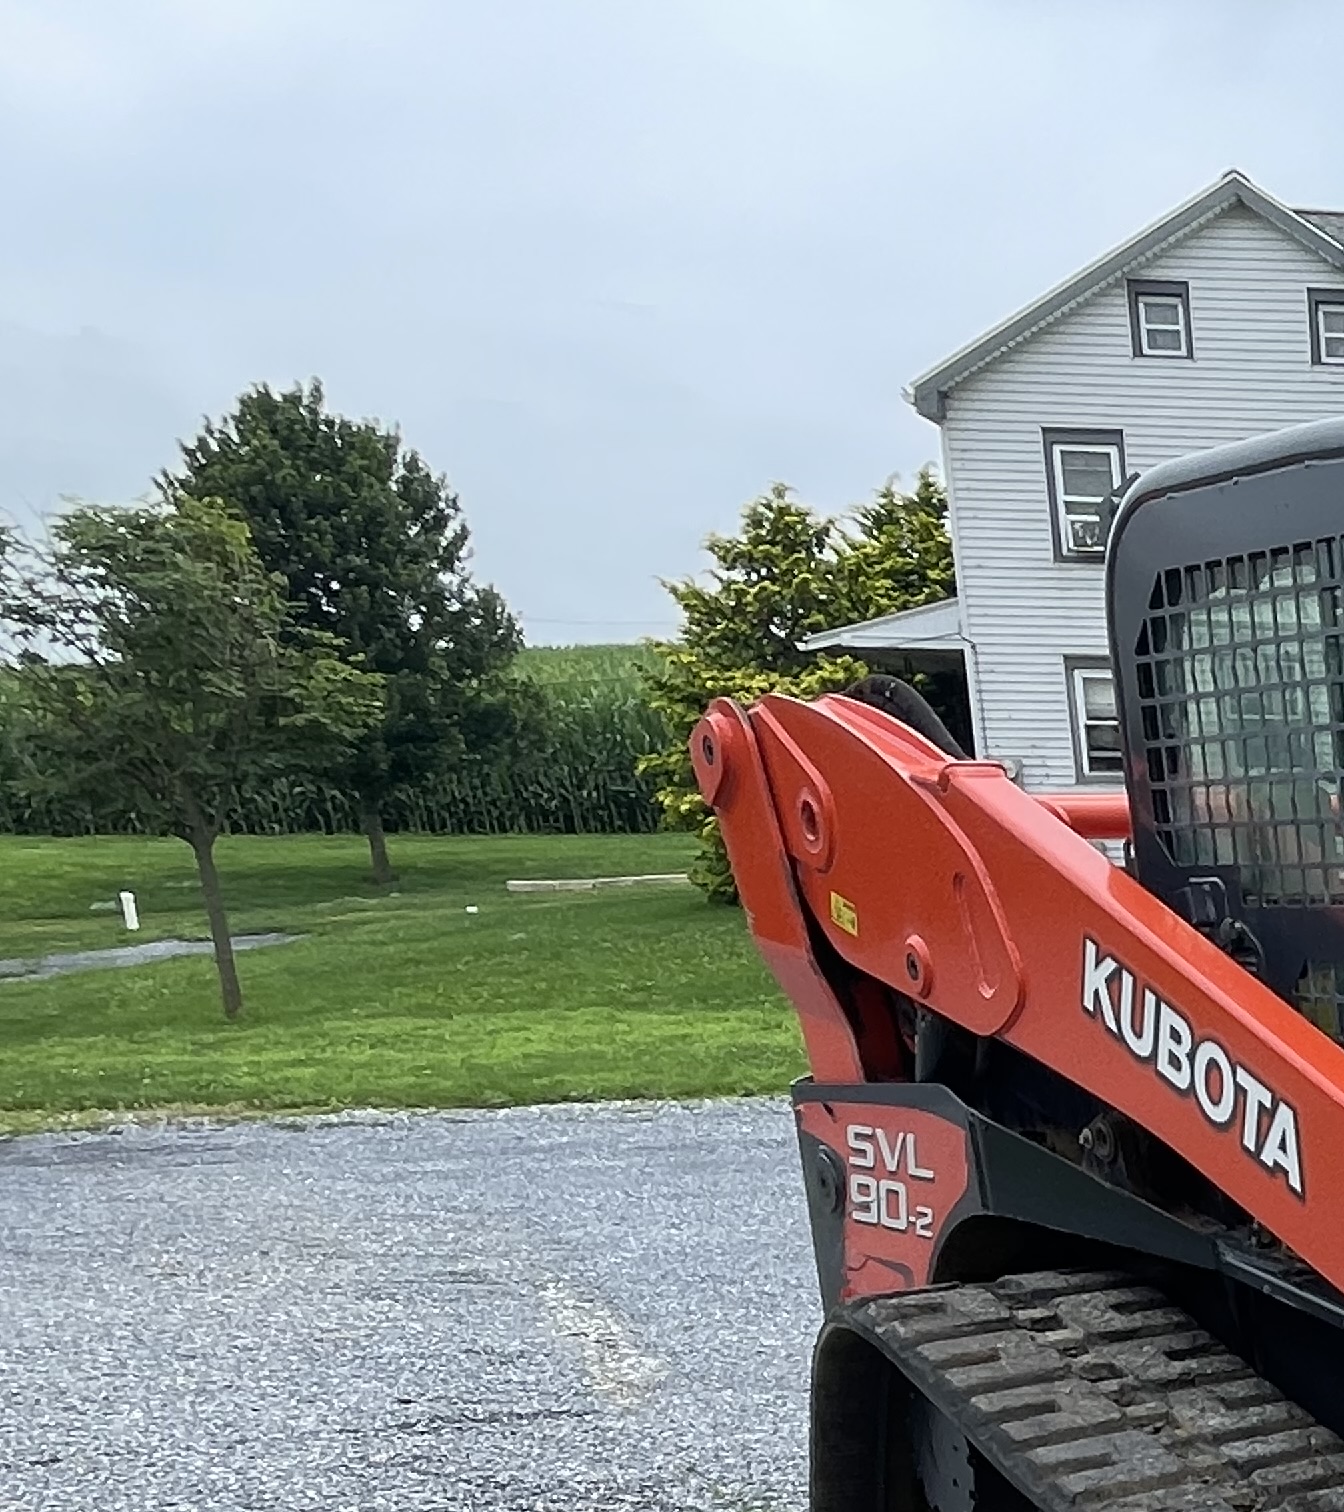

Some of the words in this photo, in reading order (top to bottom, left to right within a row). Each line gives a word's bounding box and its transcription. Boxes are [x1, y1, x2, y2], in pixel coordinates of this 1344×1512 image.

[1082, 937, 1303, 1195] KUBOTA
[846, 1124, 935, 1179] SVL
[850, 1173, 935, 1238] 90-2
